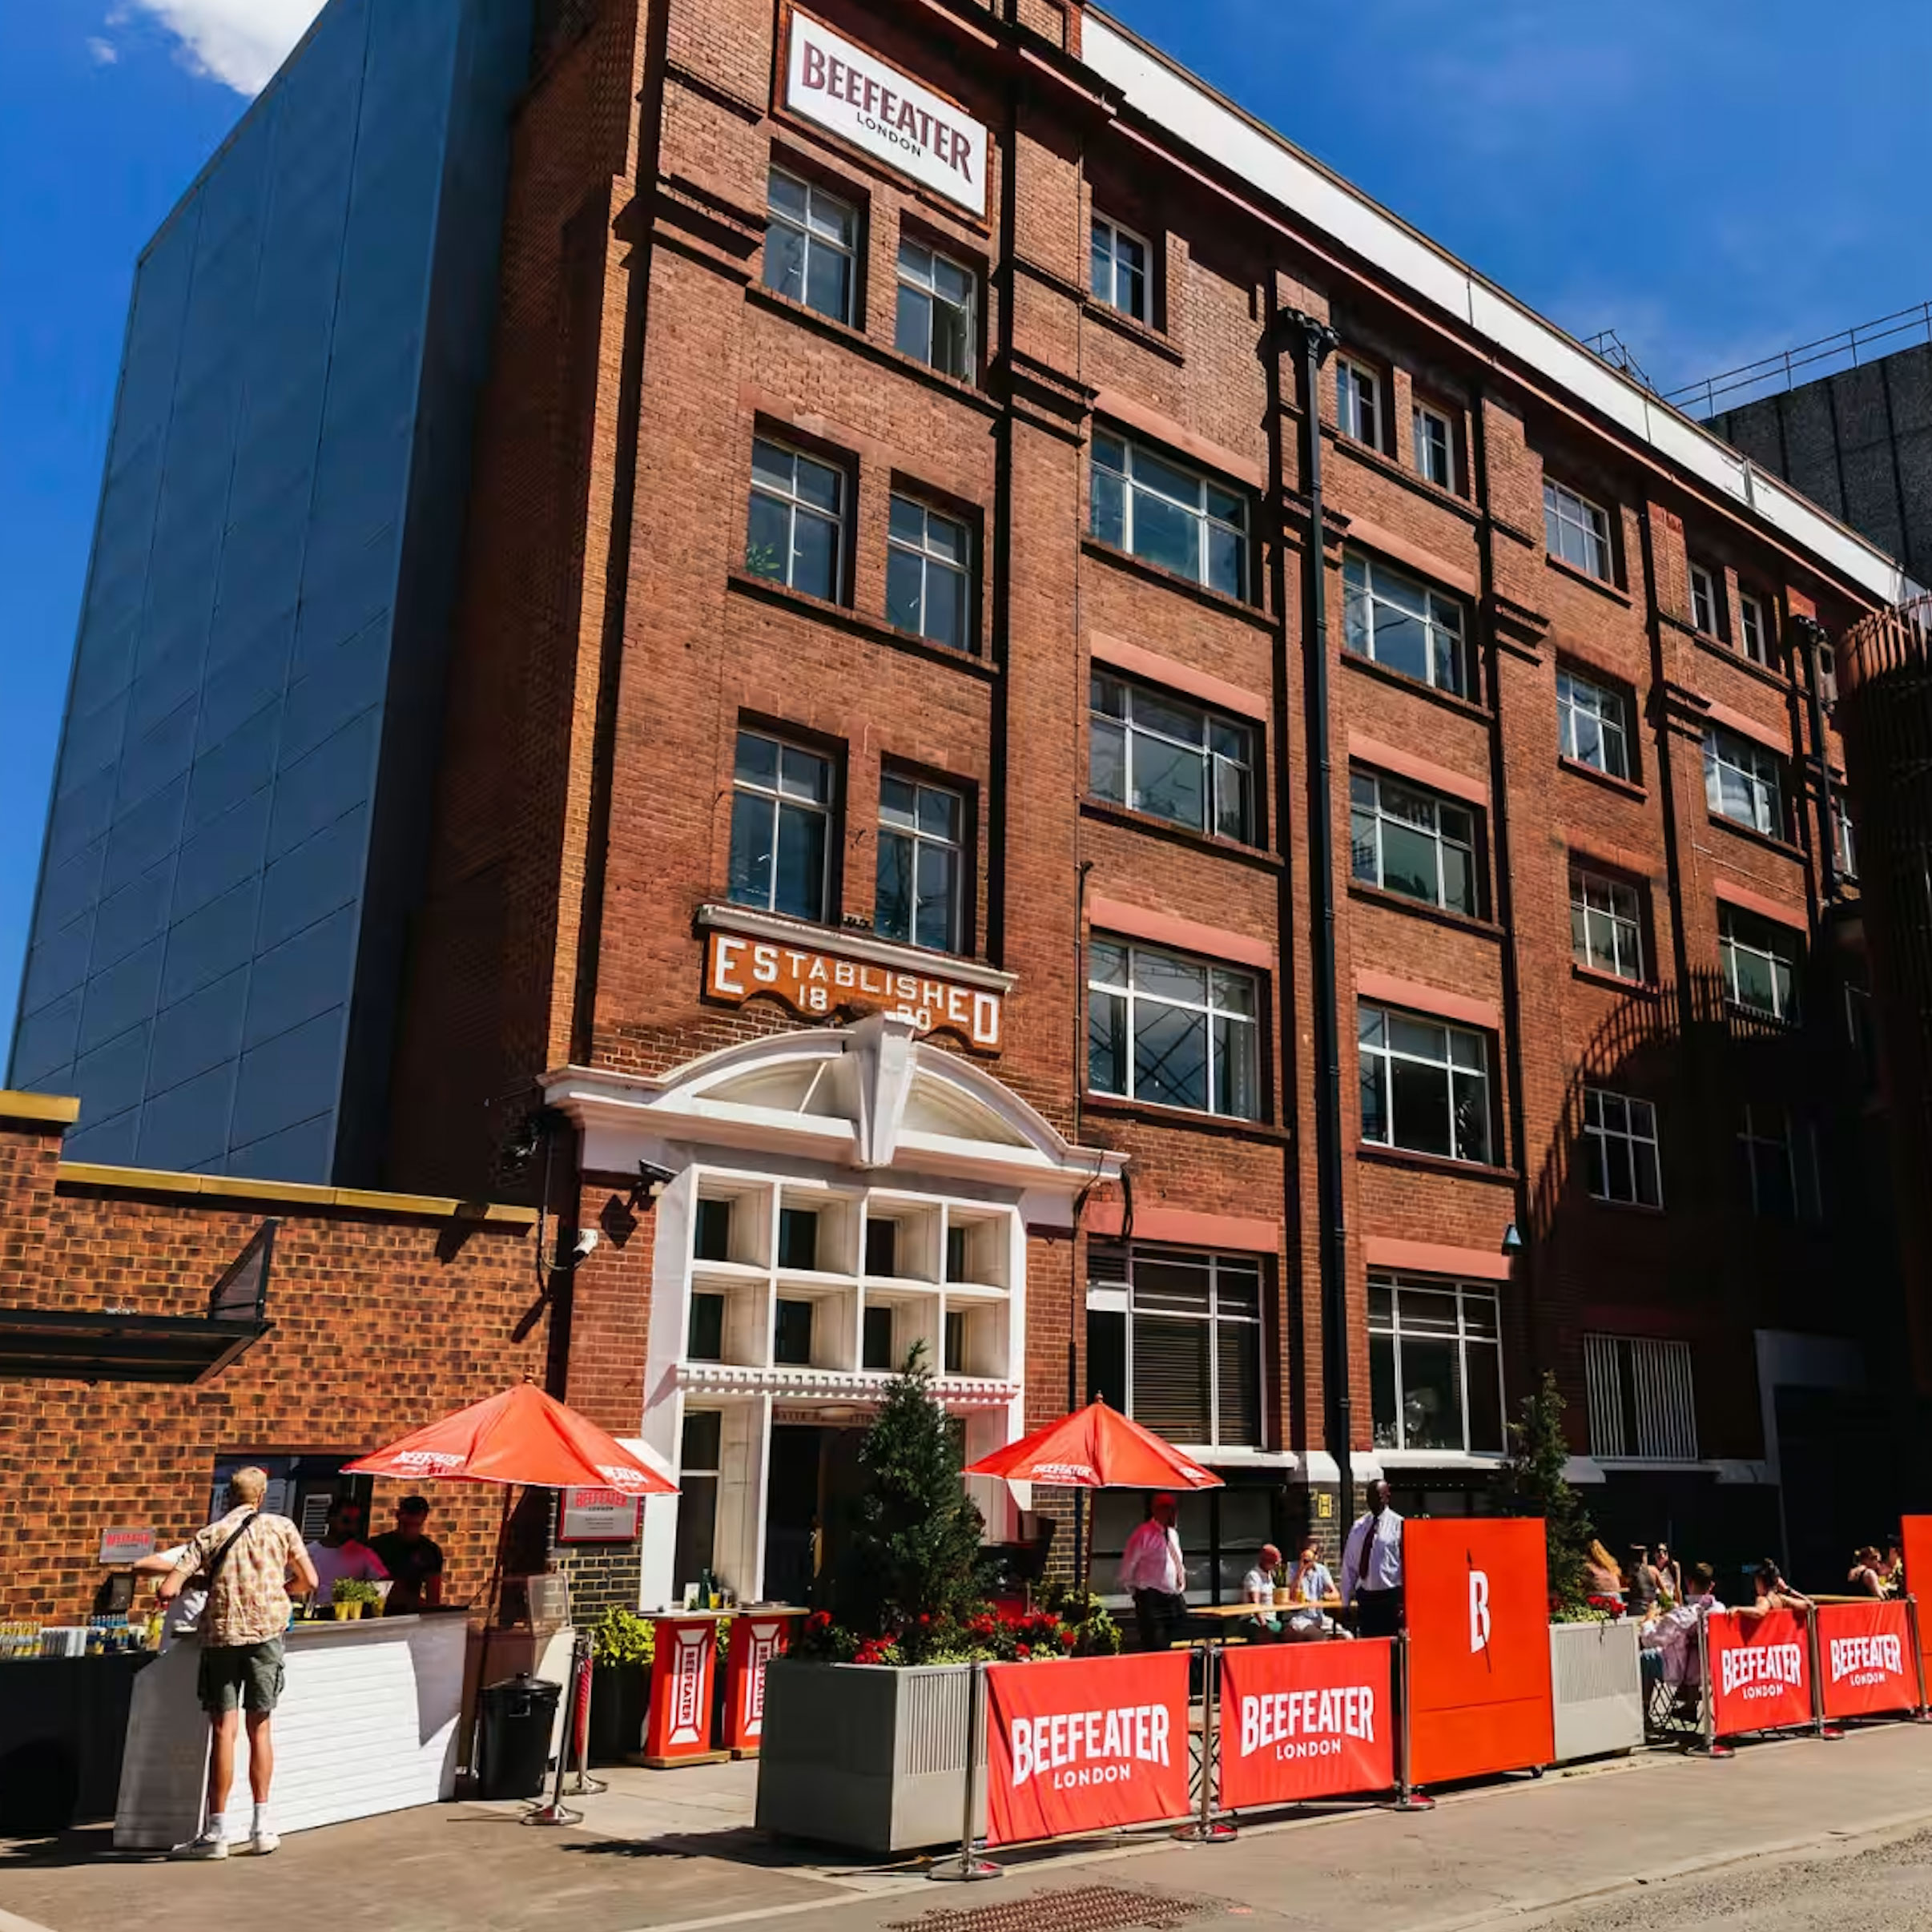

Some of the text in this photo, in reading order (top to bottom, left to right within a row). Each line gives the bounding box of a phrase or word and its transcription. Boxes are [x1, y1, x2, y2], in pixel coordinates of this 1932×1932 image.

[802, 40, 972, 183] BEEFEATER
[857, 112, 921, 158] LONDON
[714, 936, 1000, 1044] ESTABLISHED
[799, 984, 827, 1011] 18
[1469, 1571, 1491, 1653] B
[1722, 1644, 1801, 1697] BEEFEATER
[1829, 1634, 1903, 1683] BEEFEATER
[1849, 1672, 1886, 1687] LONDON
[682, 1652, 694, 1721] BEEFEATER
[1742, 1683, 1783, 1700] LONDON
[1012, 1704, 1170, 1787] BEEFEATER
[1241, 1685, 1375, 1758] BEEFEATER
[1276, 1738, 1342, 1761] LONDON
[1054, 1764, 1131, 1789] LONDON
